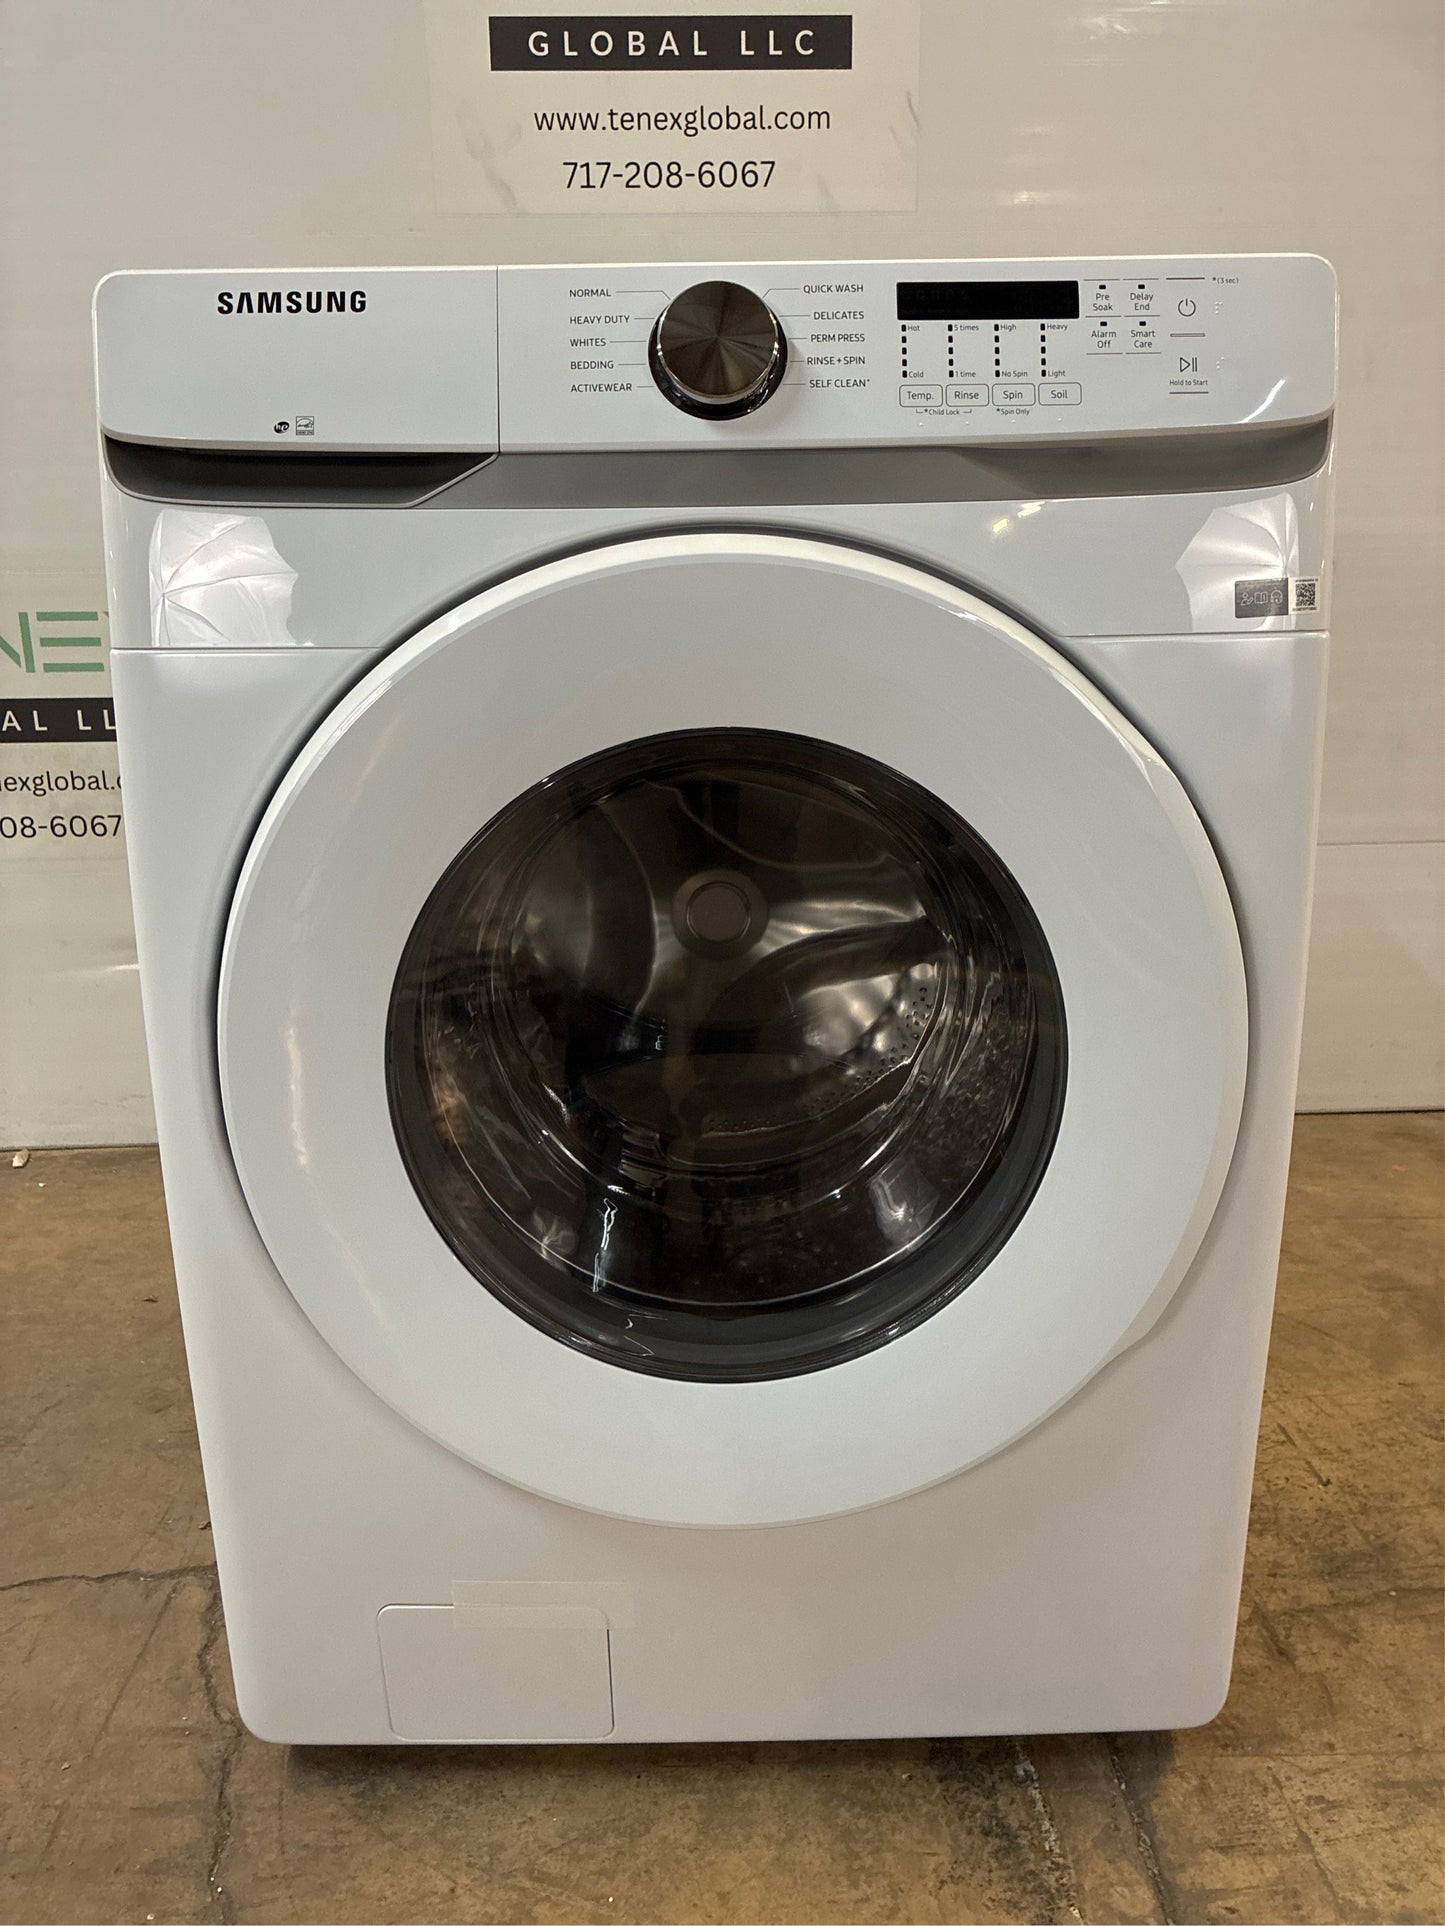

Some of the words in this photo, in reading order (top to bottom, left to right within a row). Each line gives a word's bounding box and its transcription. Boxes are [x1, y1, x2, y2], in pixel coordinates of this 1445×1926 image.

[527, 31, 708, 57] GLOBAL
[740, 29, 815, 56] LLC
[534, 105, 831, 137] www.tenexglobal.com
[562, 161, 776, 189] 717-208-6067
[1225, 277, 1239, 285] sec)
[569, 288, 612, 298] NORMAL
[803, 284, 833, 295] QUICK
[834, 284, 864, 293] WASH
[1095, 292, 1110, 301] Pre
[1129, 292, 1154, 302] Delay
[217, 290, 367, 315] SAMSUNG
[1092, 302, 1113, 312] Soak
[1134, 302, 1150, 311] End
[569, 315, 602, 325] HEAVY
[604, 315, 631, 324] DUTY
[813, 310, 865, 320] DELICATES
[907, 324, 920, 332] Hot
[960, 323, 980, 331] times
[1000, 323, 1017, 331] High
[1046, 322, 1068, 331] Heavy
[810, 333, 836, 343] PERM
[837, 333, 866, 342] PRESS
[1091, 330, 1117, 338] Alarm
[1130, 330, 1156, 338] Smart
[569, 337, 607, 347] WHITES
[1097, 340, 1111, 349] Off
[1133, 340, 1153, 348] Care
[570, 360, 615, 370] BEDDING
[908, 370, 925, 378] Cold
[960, 370, 976, 378] time
[1001, 370, 1012, 378] No
[1013, 370, 1028, 379] Spin
[1047, 369, 1066, 378] Light
[809, 379, 833, 389] SELF
[1169, 378, 1184, 386] Hold
[1192, 378, 1208, 386] Start
[570, 382, 633, 393] ACTIVEWEAR
[907, 390, 935, 401] Temp.
[954, 390, 980, 400] Rinse
[1003, 390, 1023, 401] Spin
[1050, 389, 1068, 399] Soil
[1015, 407, 1030, 416] Only
[2, 709, 48, 732] AL
[0, 770, 121, 797] exglobal.
[0, 815, 122, 838] 08-6067
